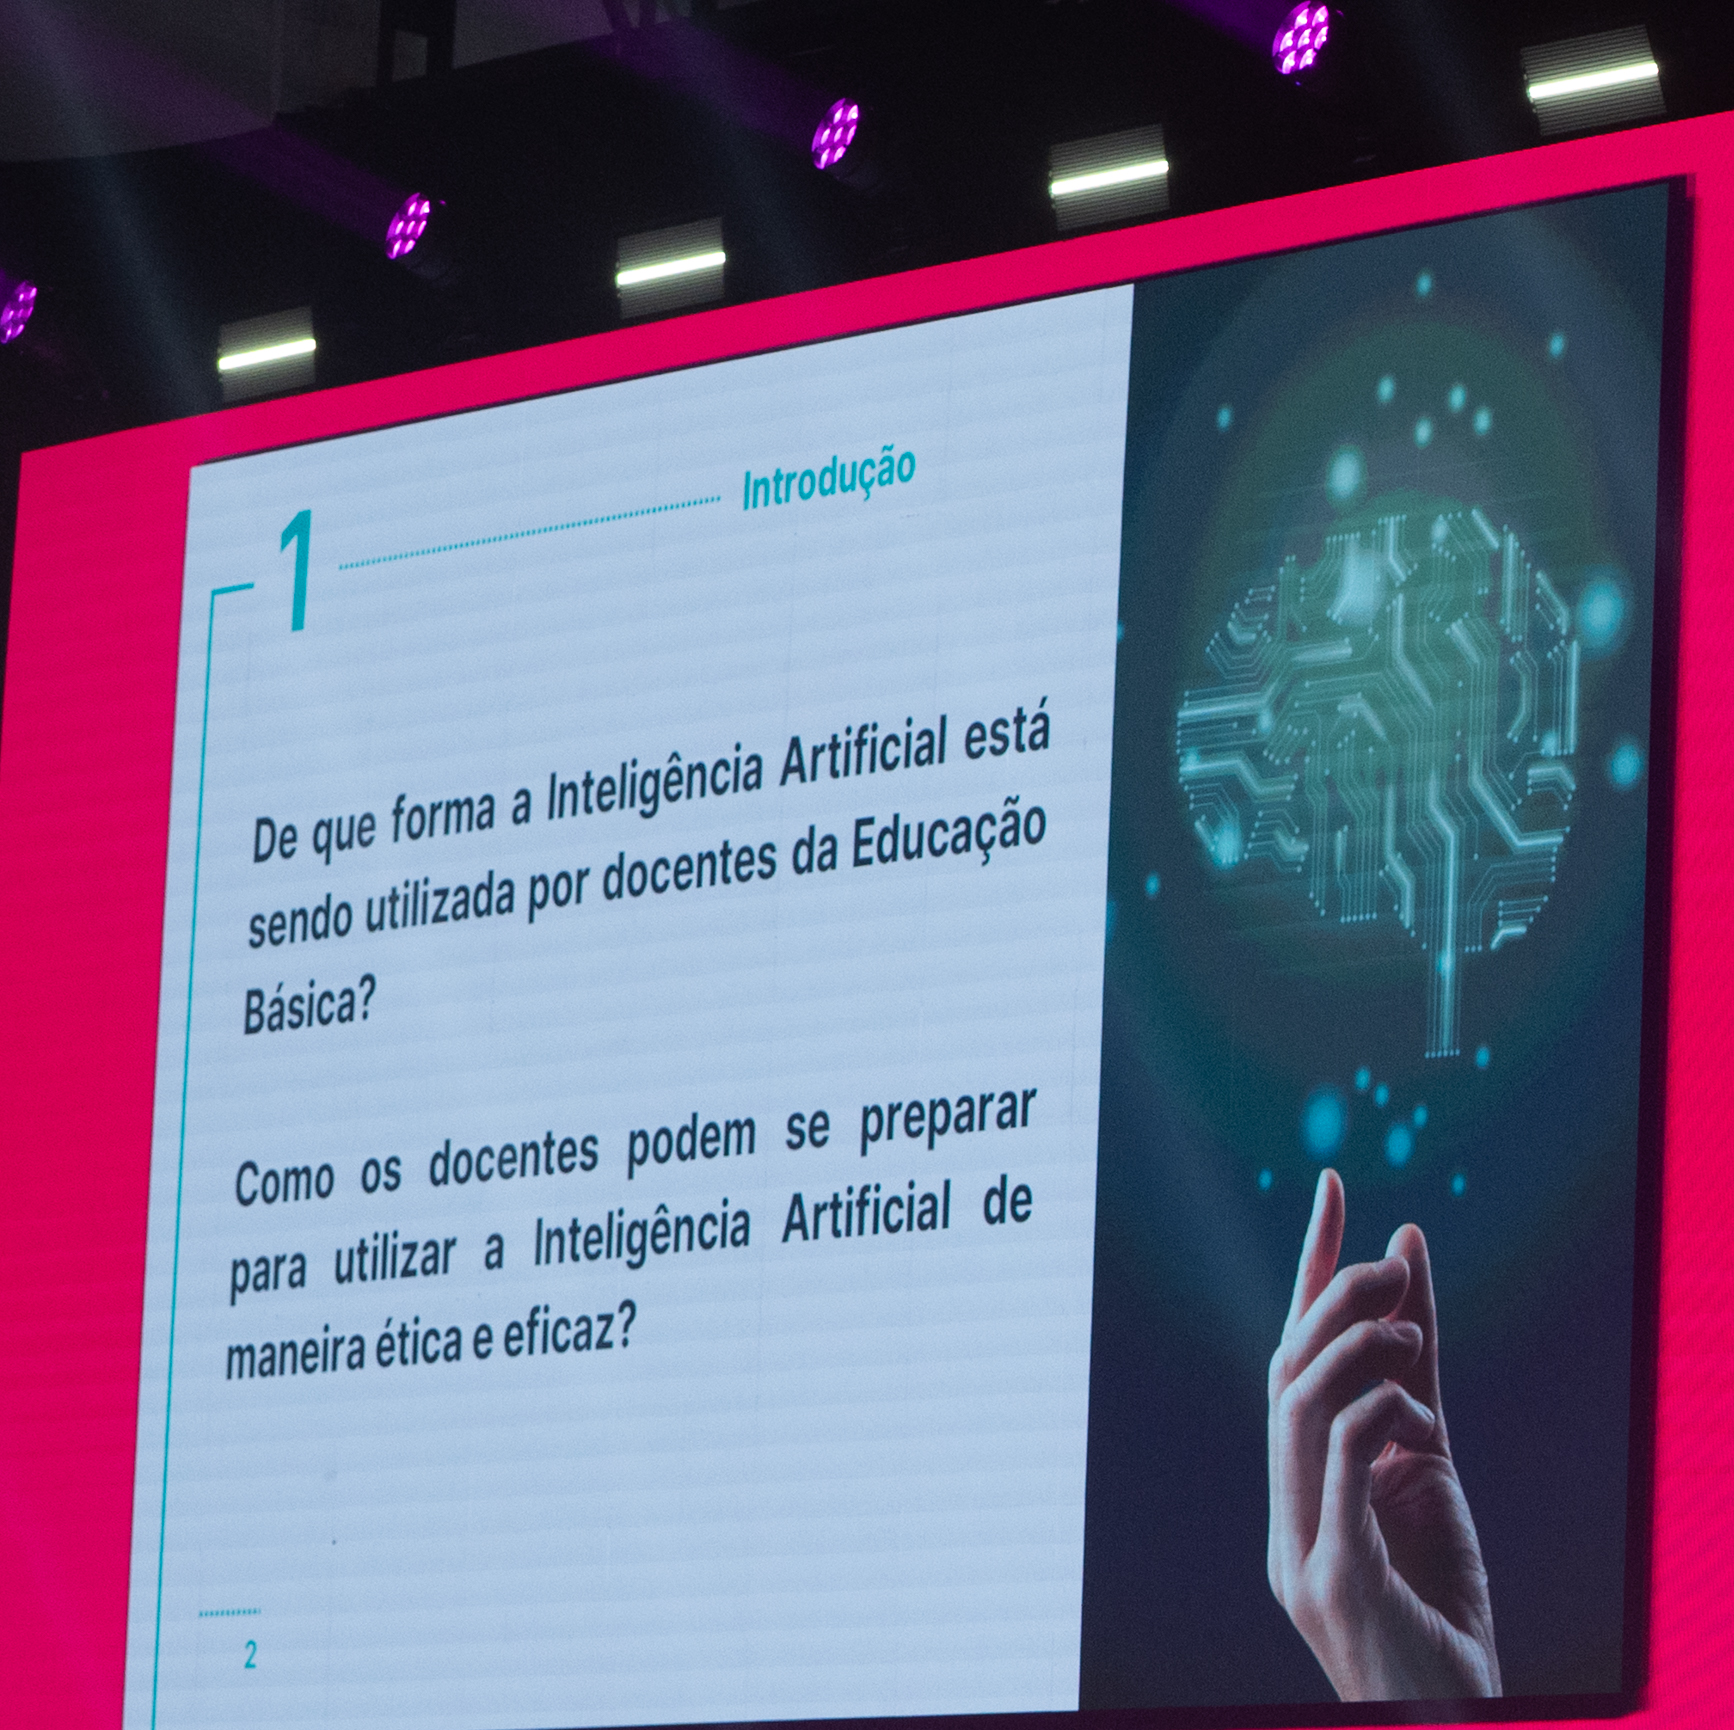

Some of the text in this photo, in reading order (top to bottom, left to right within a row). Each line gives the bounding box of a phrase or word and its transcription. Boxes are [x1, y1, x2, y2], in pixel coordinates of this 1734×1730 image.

[742, 443, 917, 512] Introdução
[279, 508, 313, 633] 1
[252, 695, 1051, 867] De que forma a Inteligência Artificial está
[248, 794, 1048, 950] sendo utilizada por docentes da Educação
[243, 972, 377, 1036] Básica?
[235, 1087, 1039, 1208] Como os docentes podem se preparar
[229, 1172, 1034, 1308] para utilizar a Inteligência Artificial de
[225, 1298, 638, 1381] maneira ética e eficaz?
[243, 1638, 258, 1670] 2
